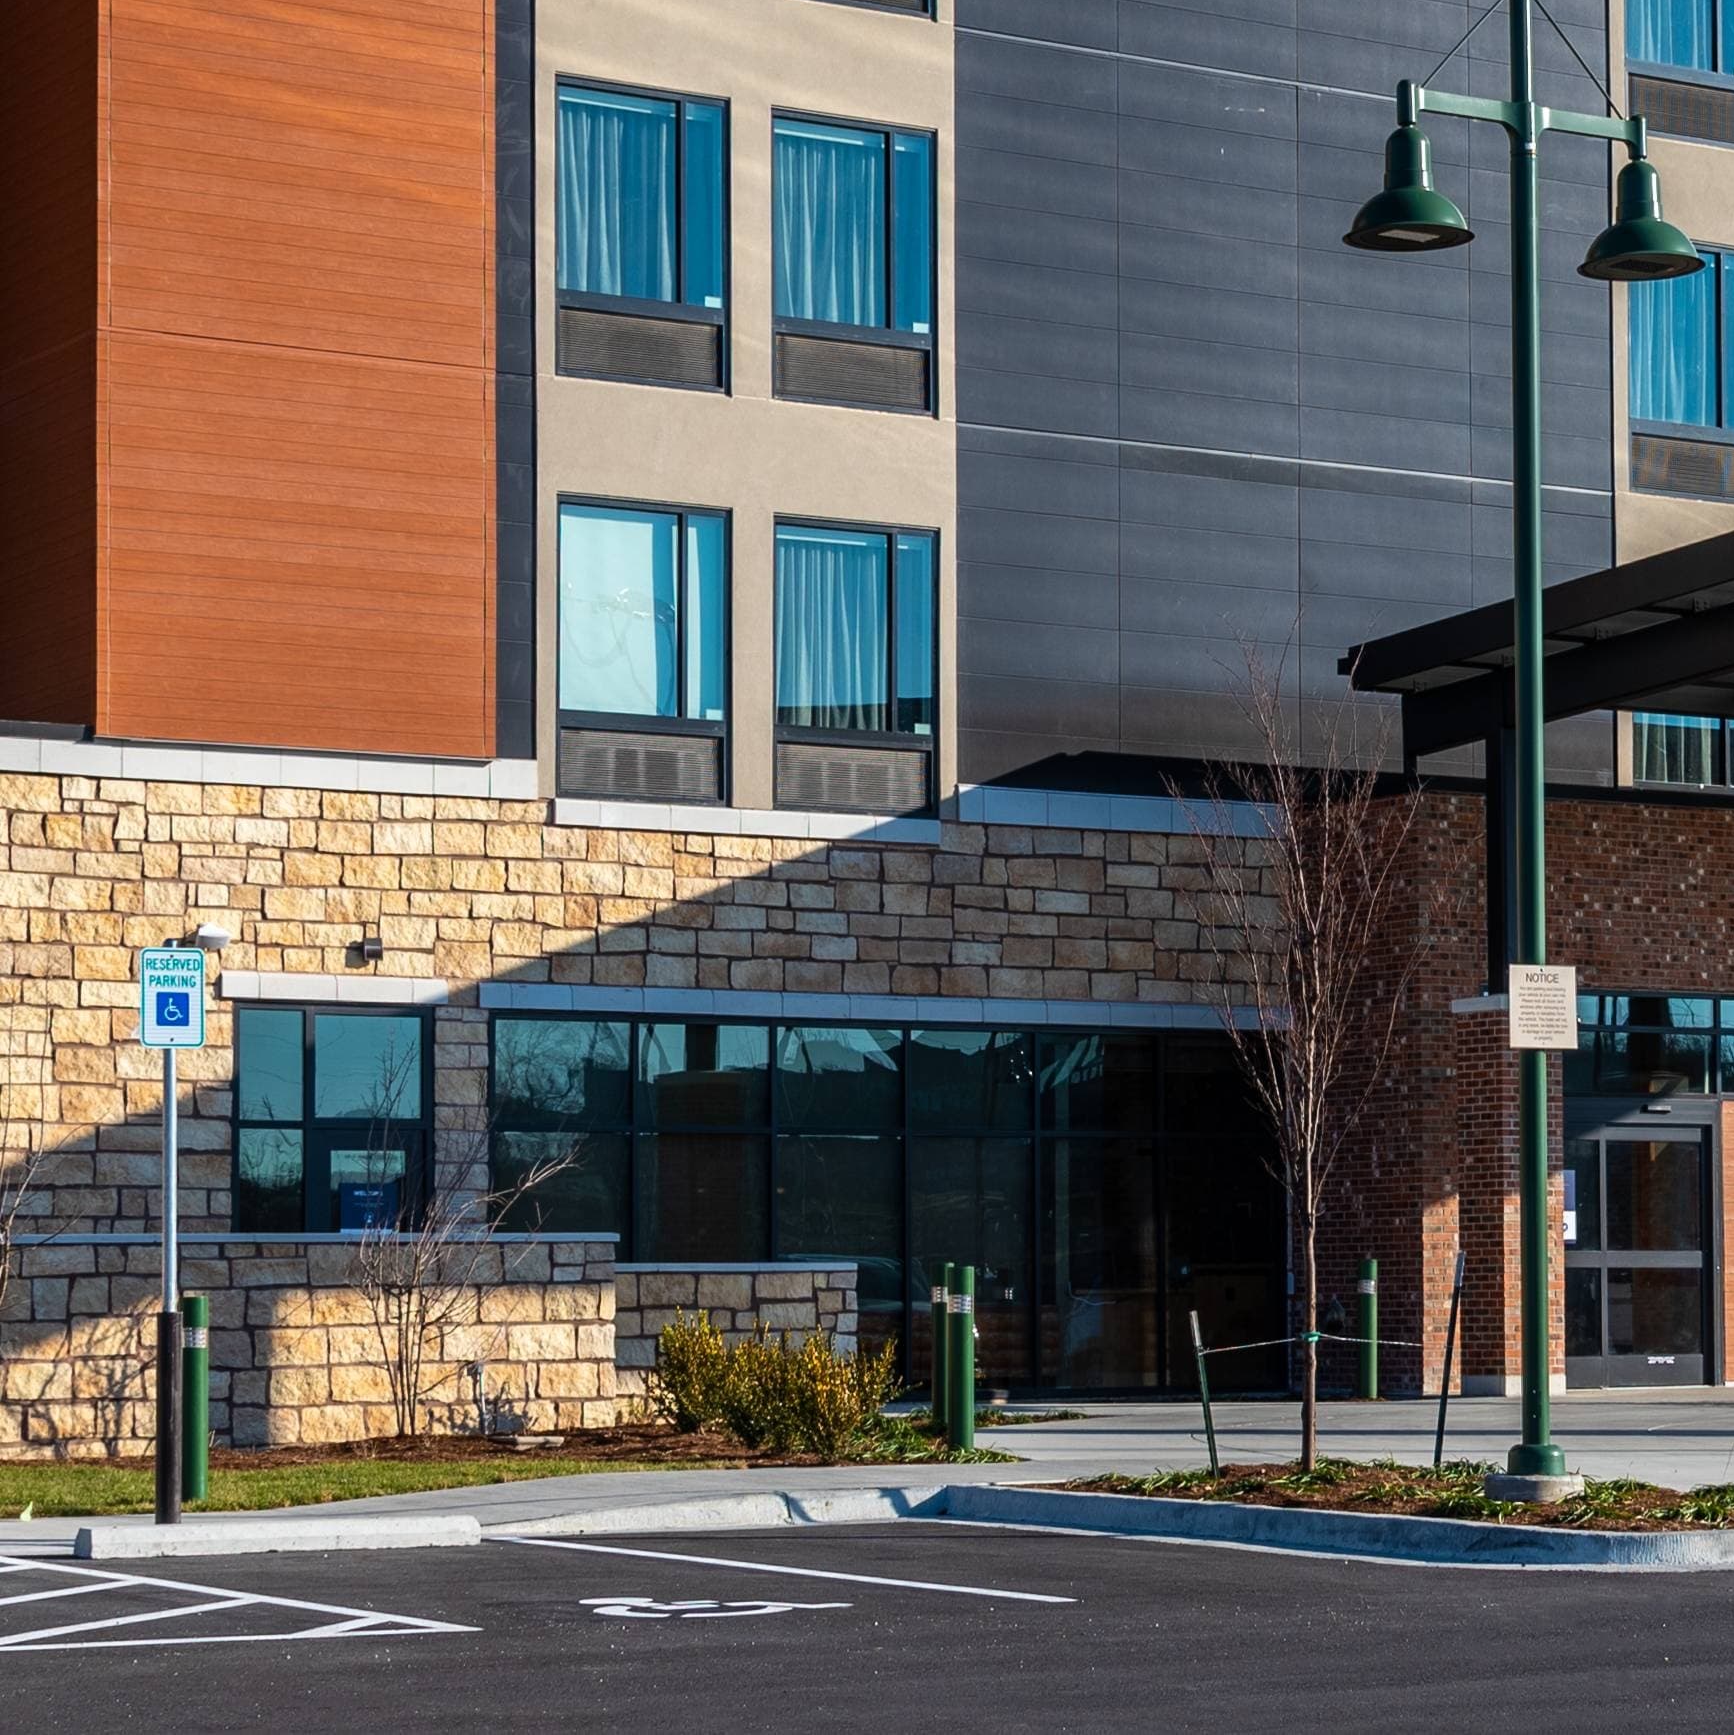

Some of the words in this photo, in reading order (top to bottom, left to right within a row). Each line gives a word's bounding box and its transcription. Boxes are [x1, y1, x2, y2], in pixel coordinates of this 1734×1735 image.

[145, 958, 201, 971] RESERVED
[149, 975, 197, 988] PARKING
[1525, 972, 1560, 984] NOTICE
